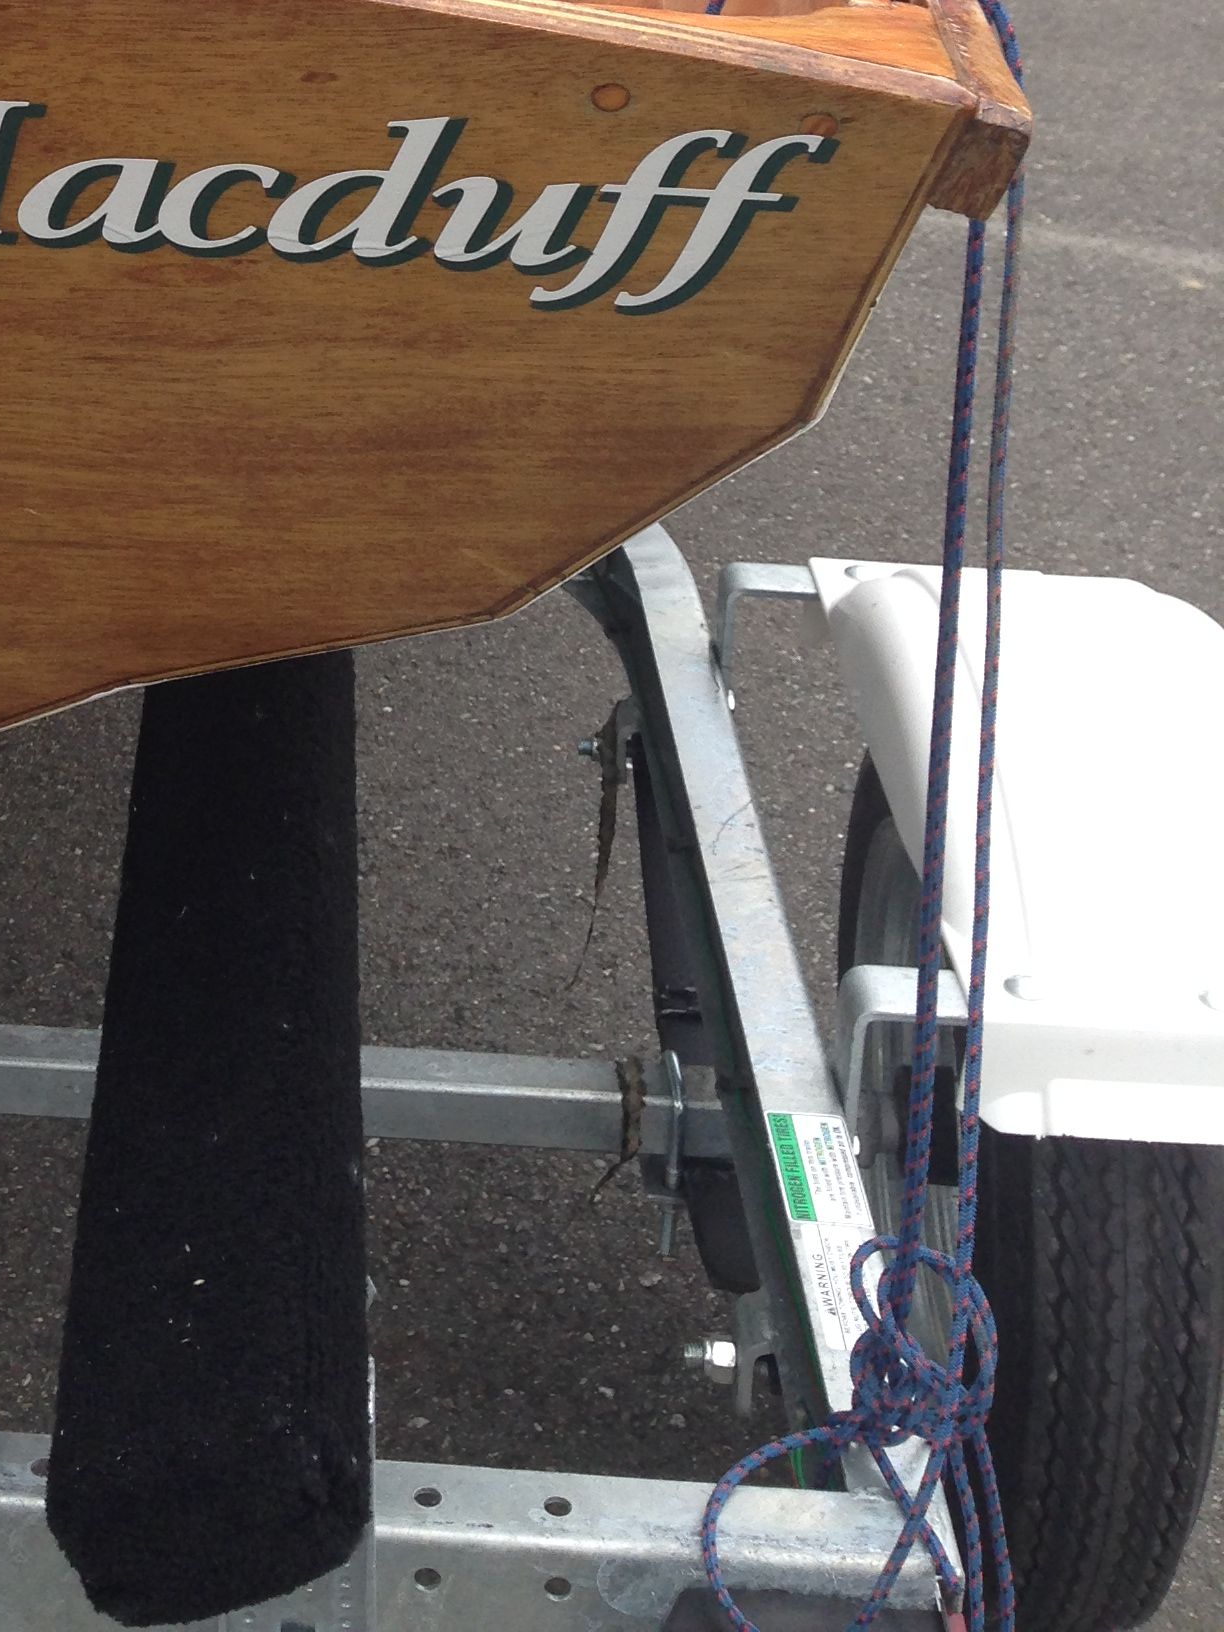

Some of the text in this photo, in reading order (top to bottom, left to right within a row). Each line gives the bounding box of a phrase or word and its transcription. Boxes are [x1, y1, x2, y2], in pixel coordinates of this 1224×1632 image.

[779, 1144, 800, 1173] FILLED
[787, 1174, 811, 1220] NITROGEN
[812, 1254, 834, 1307] WARNING
